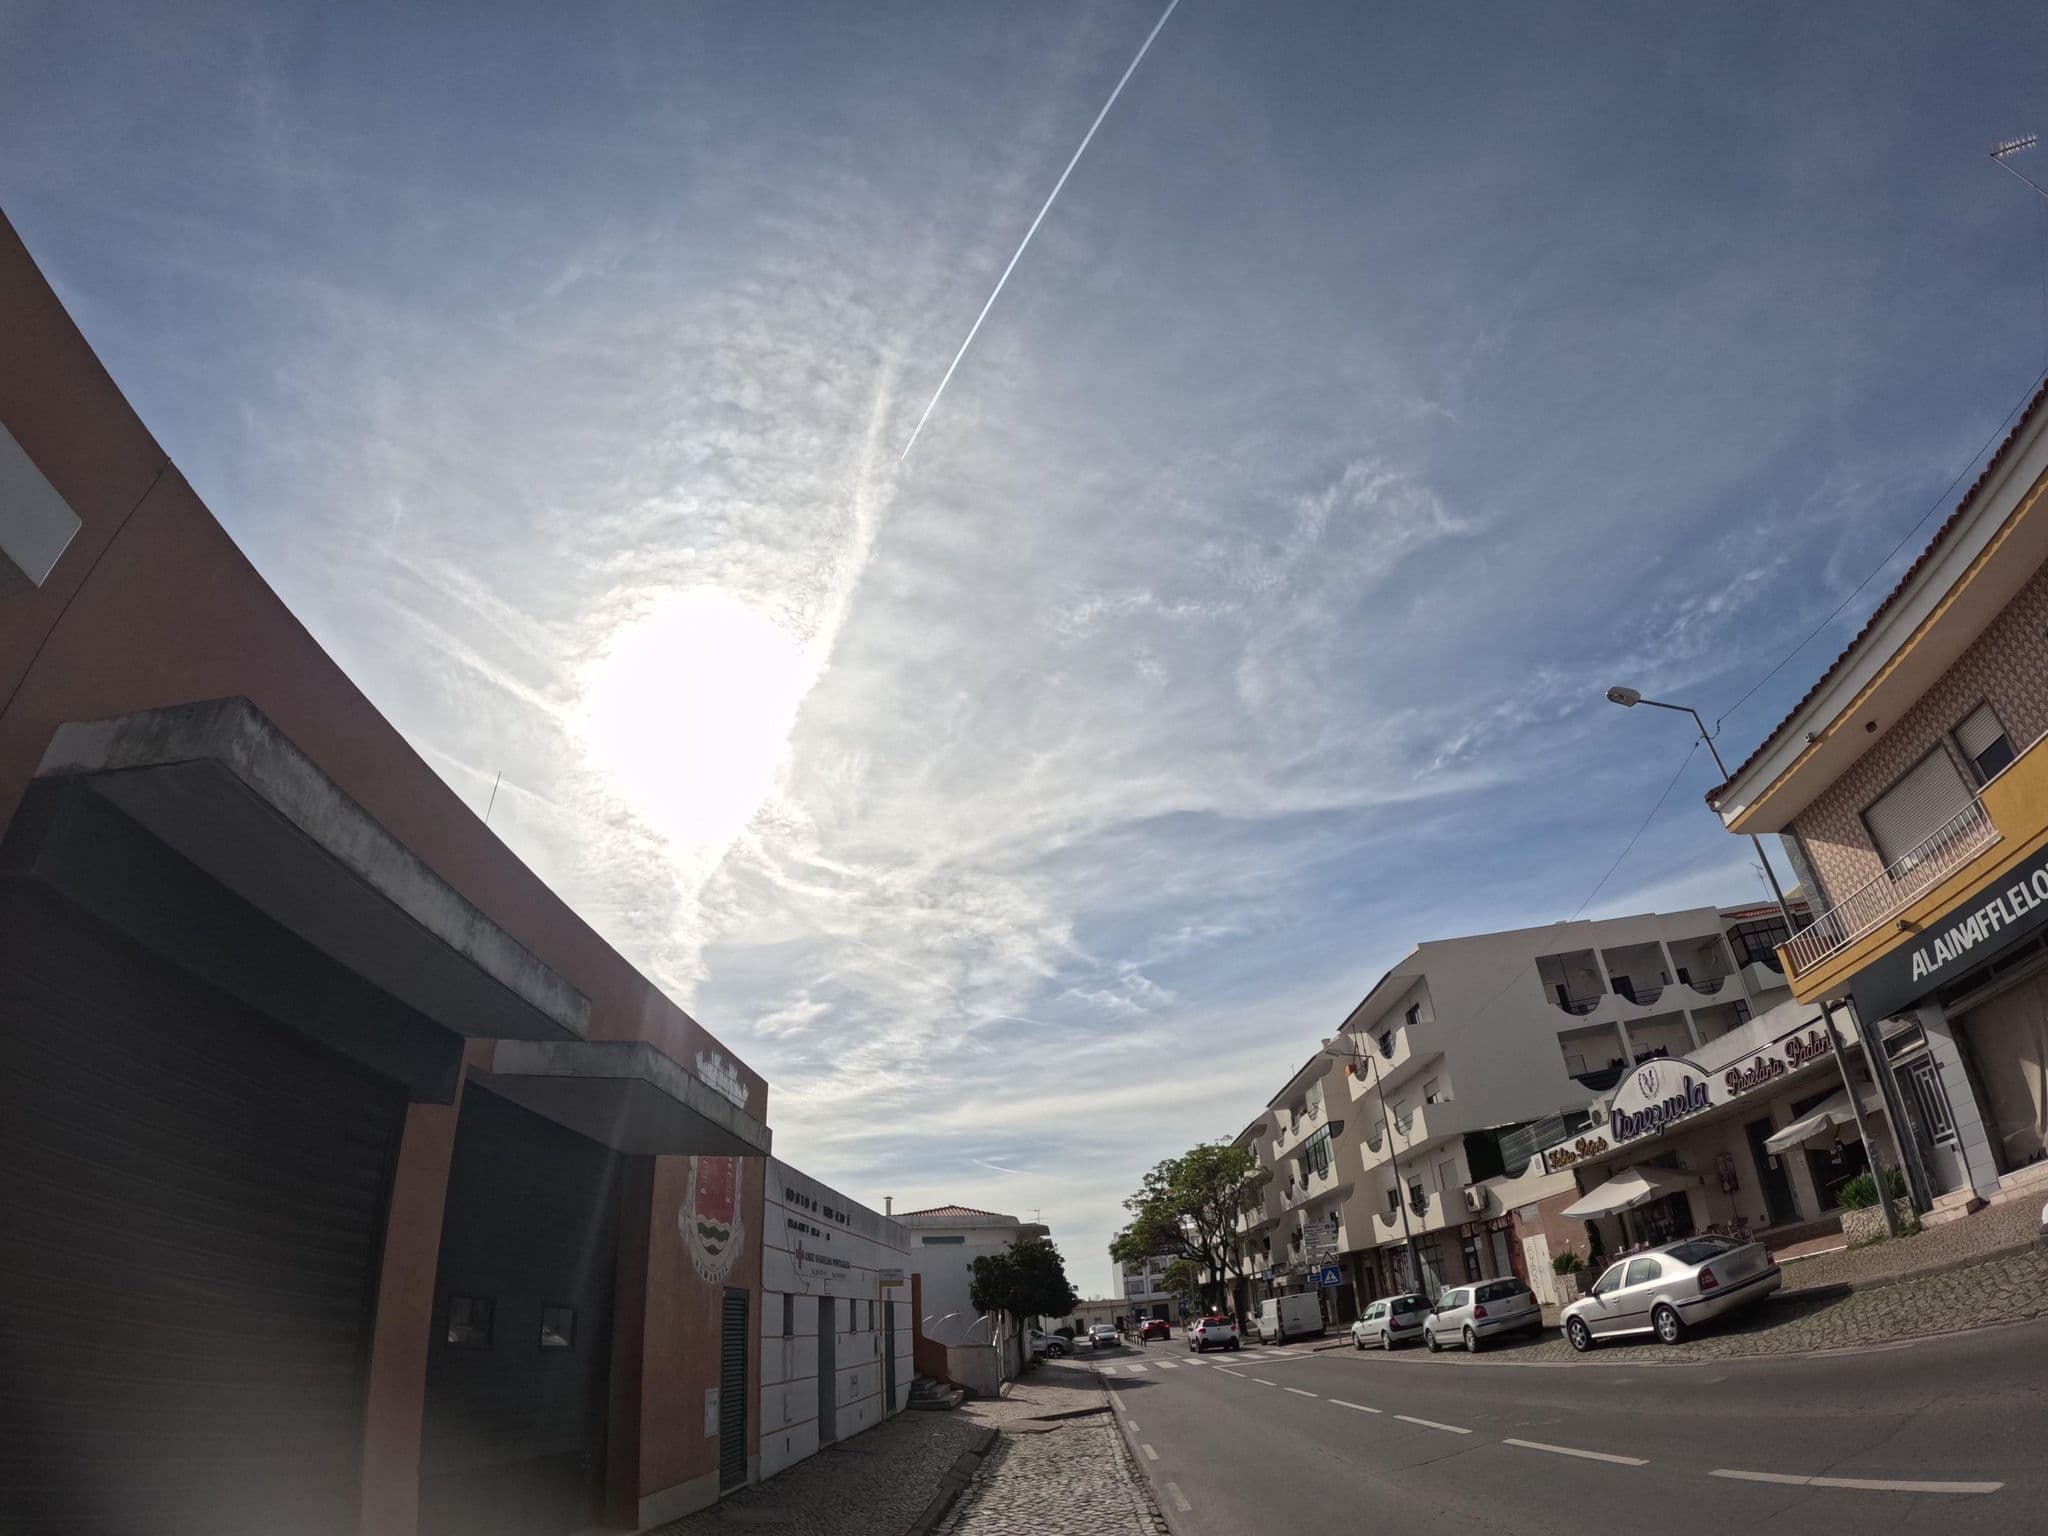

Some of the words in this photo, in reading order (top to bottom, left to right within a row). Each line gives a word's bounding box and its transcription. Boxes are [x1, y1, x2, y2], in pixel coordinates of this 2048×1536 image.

[1726, 1057, 1784, 1096] Pastelaria
[1785, 1031, 1834, 1067] Padari
[1611, 1075, 1713, 1142] Venezuela
